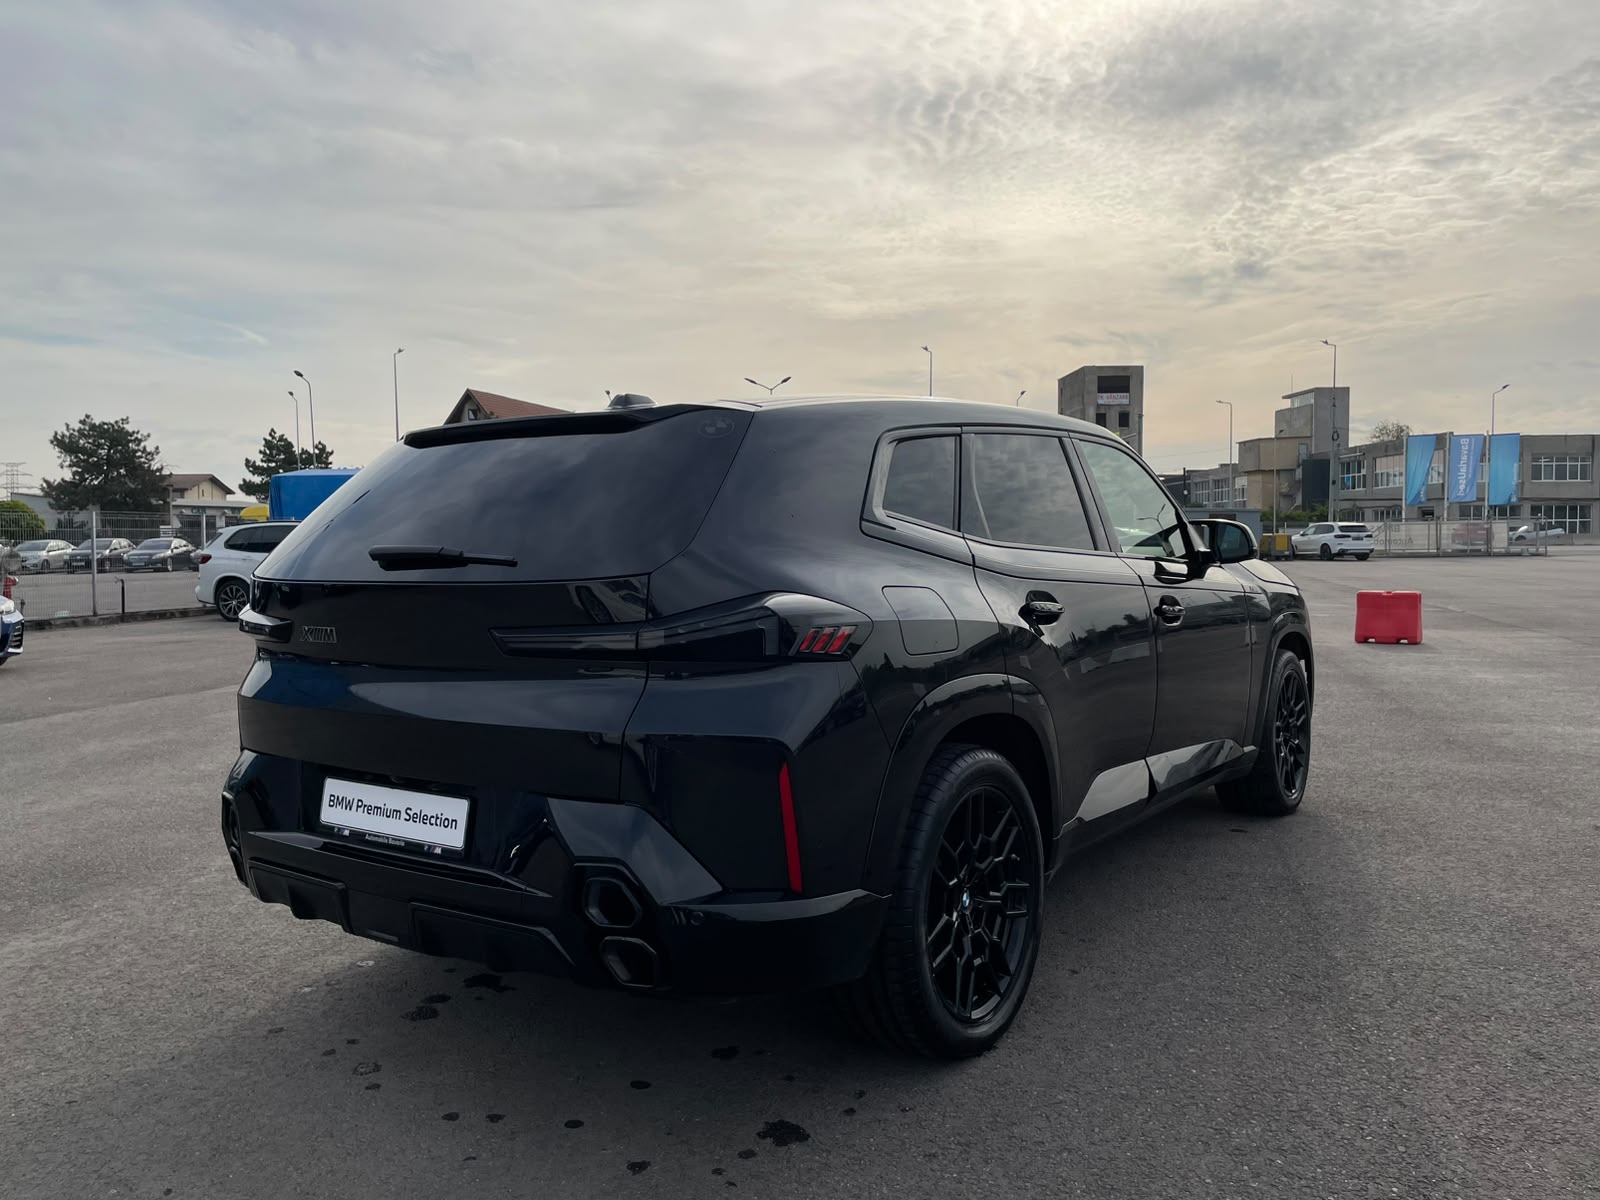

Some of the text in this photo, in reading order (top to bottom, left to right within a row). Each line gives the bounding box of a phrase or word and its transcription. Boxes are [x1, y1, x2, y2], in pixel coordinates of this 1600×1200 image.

[328, 794, 458, 830] BMW Premium Selection
